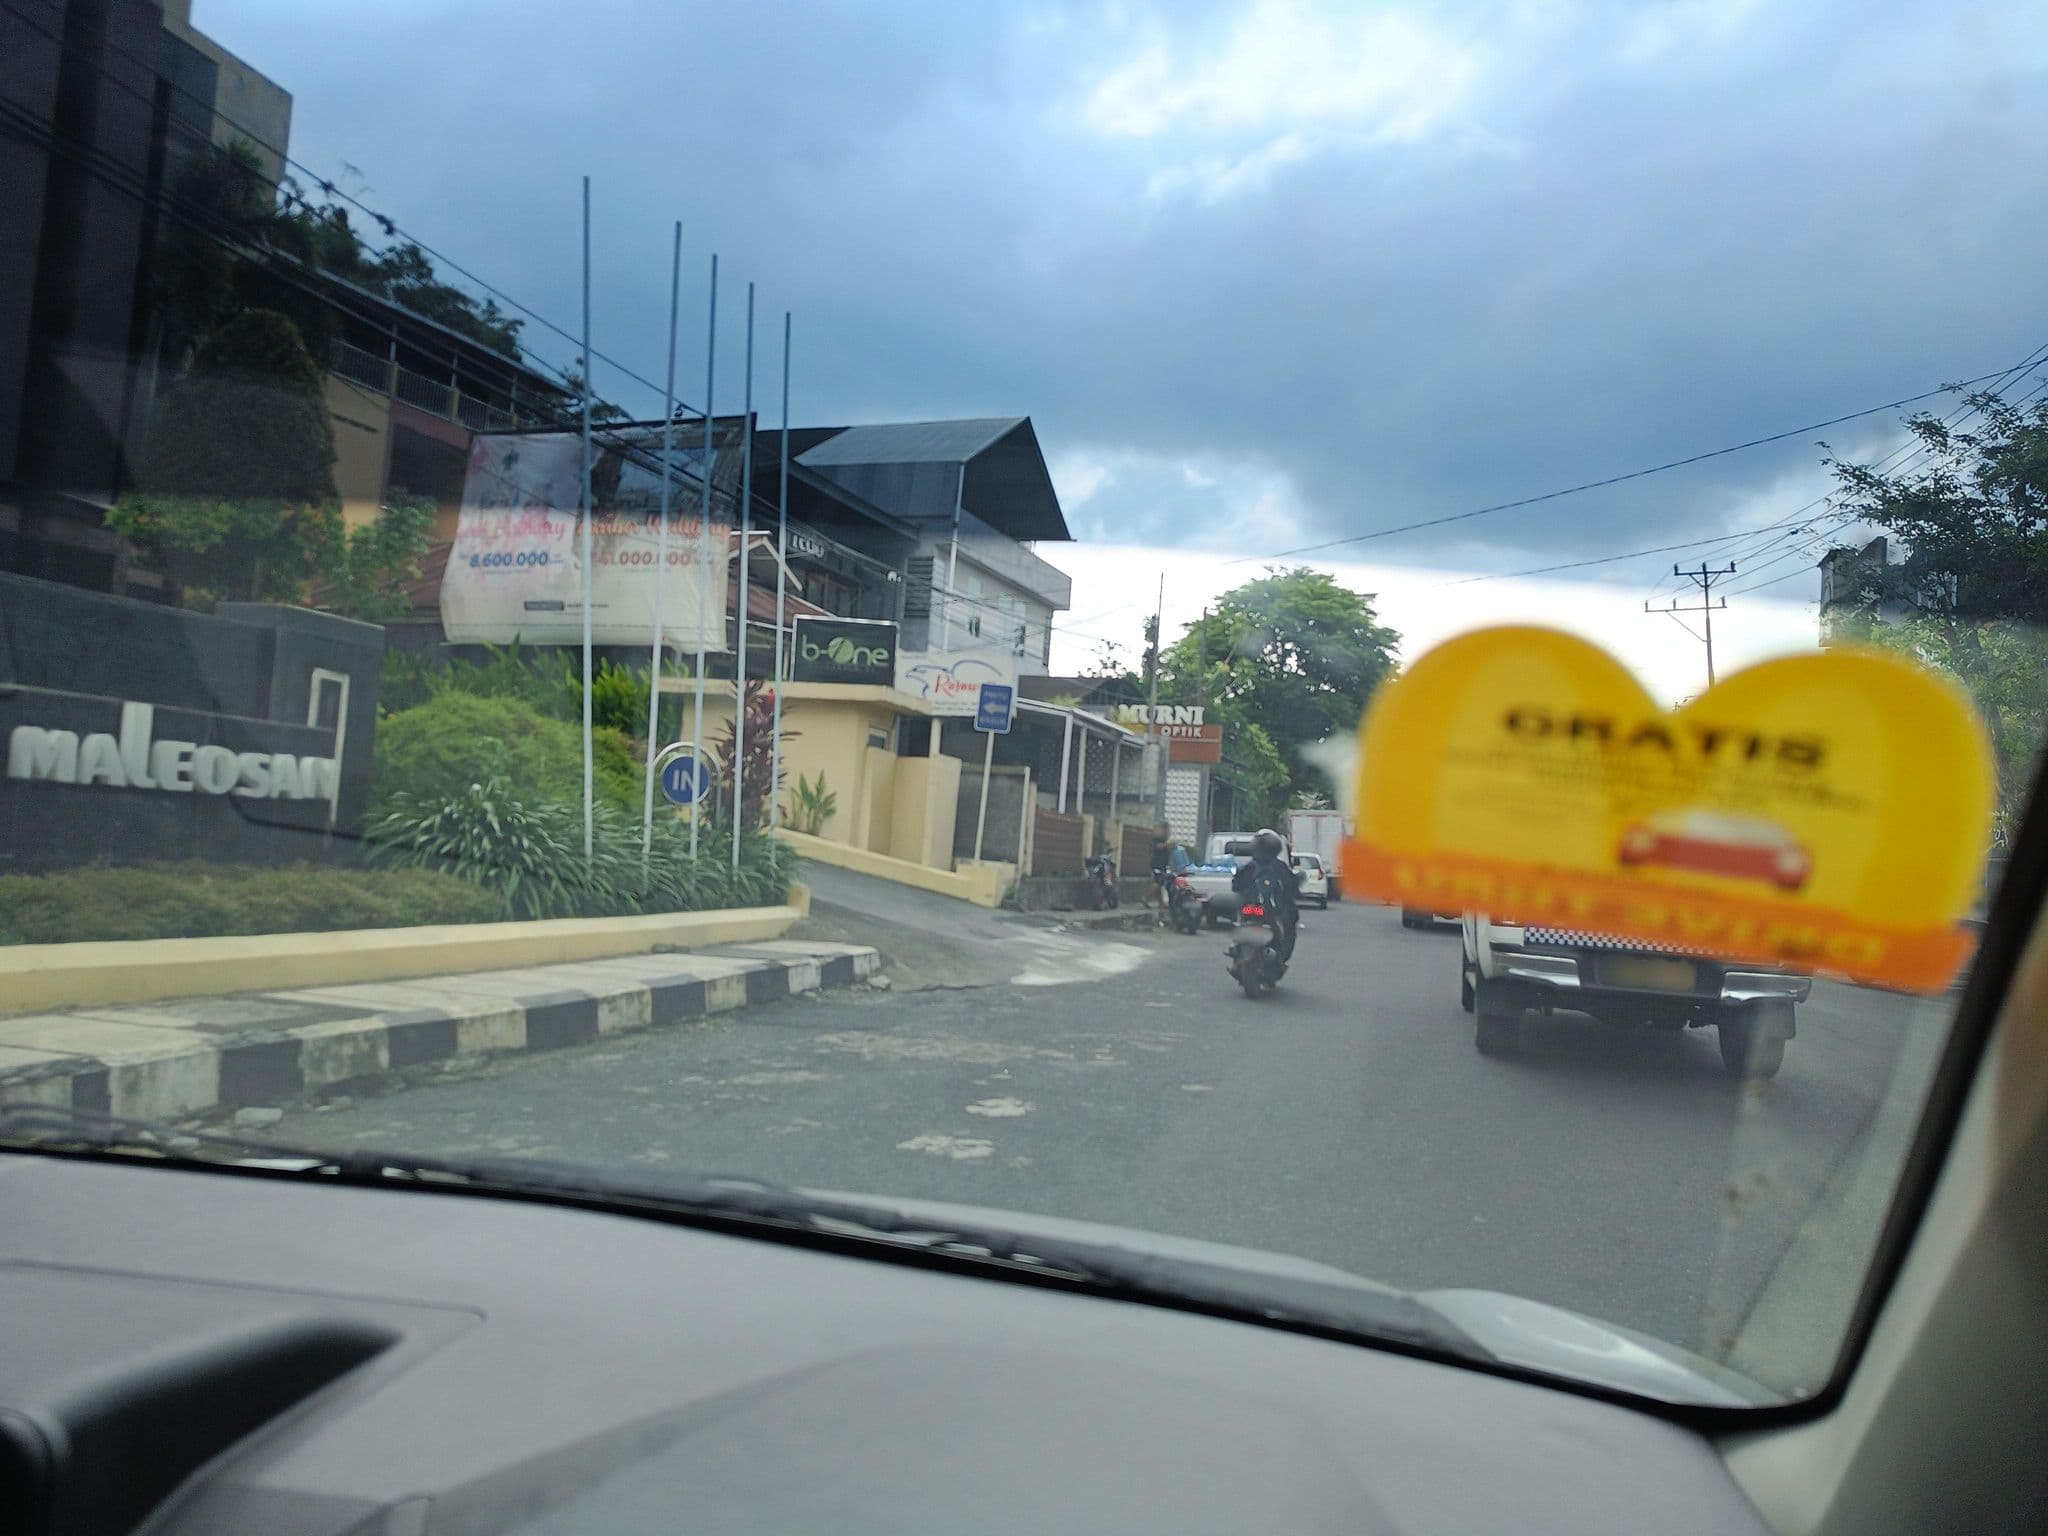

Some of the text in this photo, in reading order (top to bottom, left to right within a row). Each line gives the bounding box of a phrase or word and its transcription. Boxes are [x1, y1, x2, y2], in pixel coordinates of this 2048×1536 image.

[1117, 704, 1205, 726] MURNI
[1161, 726, 1202, 738] OPTIK
[8, 667, 349, 825] MALEOSAN
